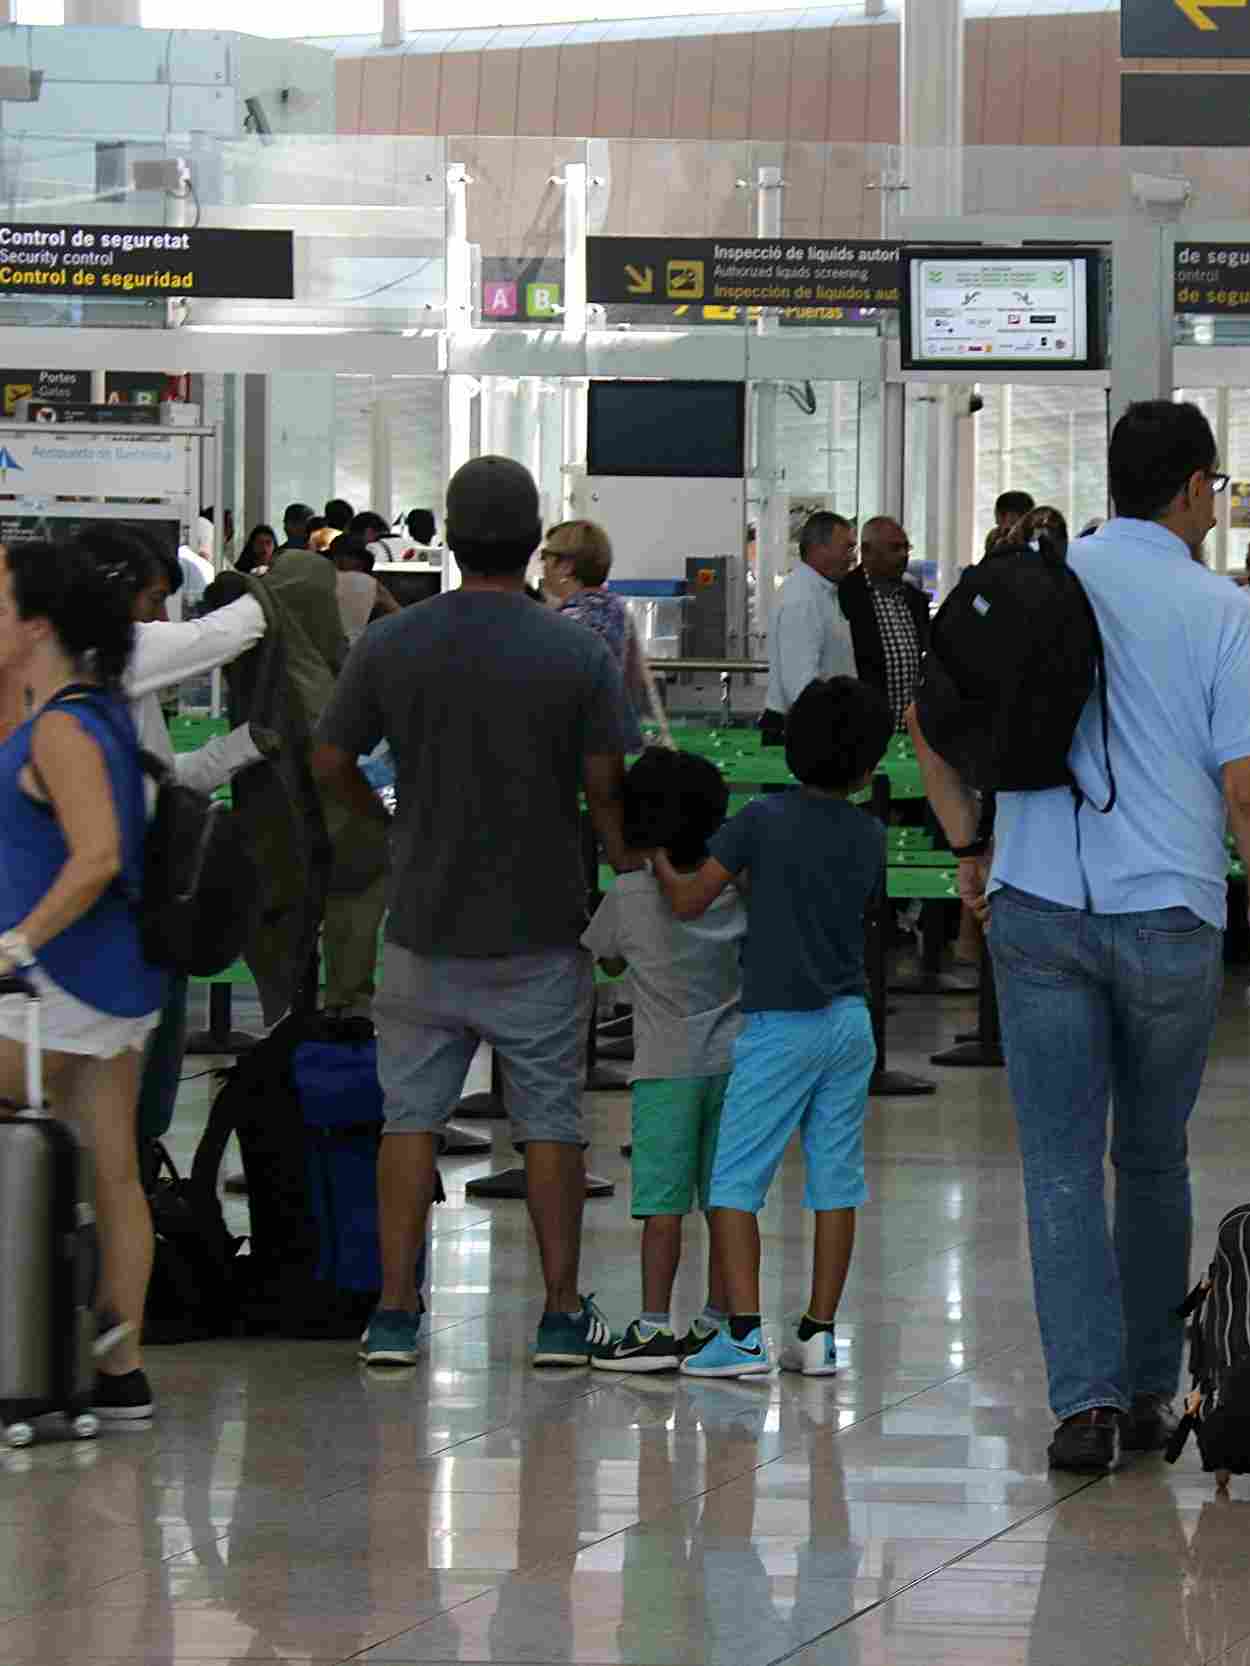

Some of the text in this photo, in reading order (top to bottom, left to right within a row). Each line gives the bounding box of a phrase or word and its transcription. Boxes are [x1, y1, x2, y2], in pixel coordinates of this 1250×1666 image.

[0, 227, 190, 251] Control de seguretat
[0, 249, 114, 268] Security control
[714, 244, 782, 262] Inspecció
[786, 246, 804, 260] de
[1178, 247, 1201, 264] de
[0, 267, 193, 291] Control de seguridad
[492, 287, 510, 309] A
[534, 287, 551, 309] B
[794, 284, 812, 298] de
[1178, 287, 1201, 304] de
[39, 371, 77, 384] Portes
